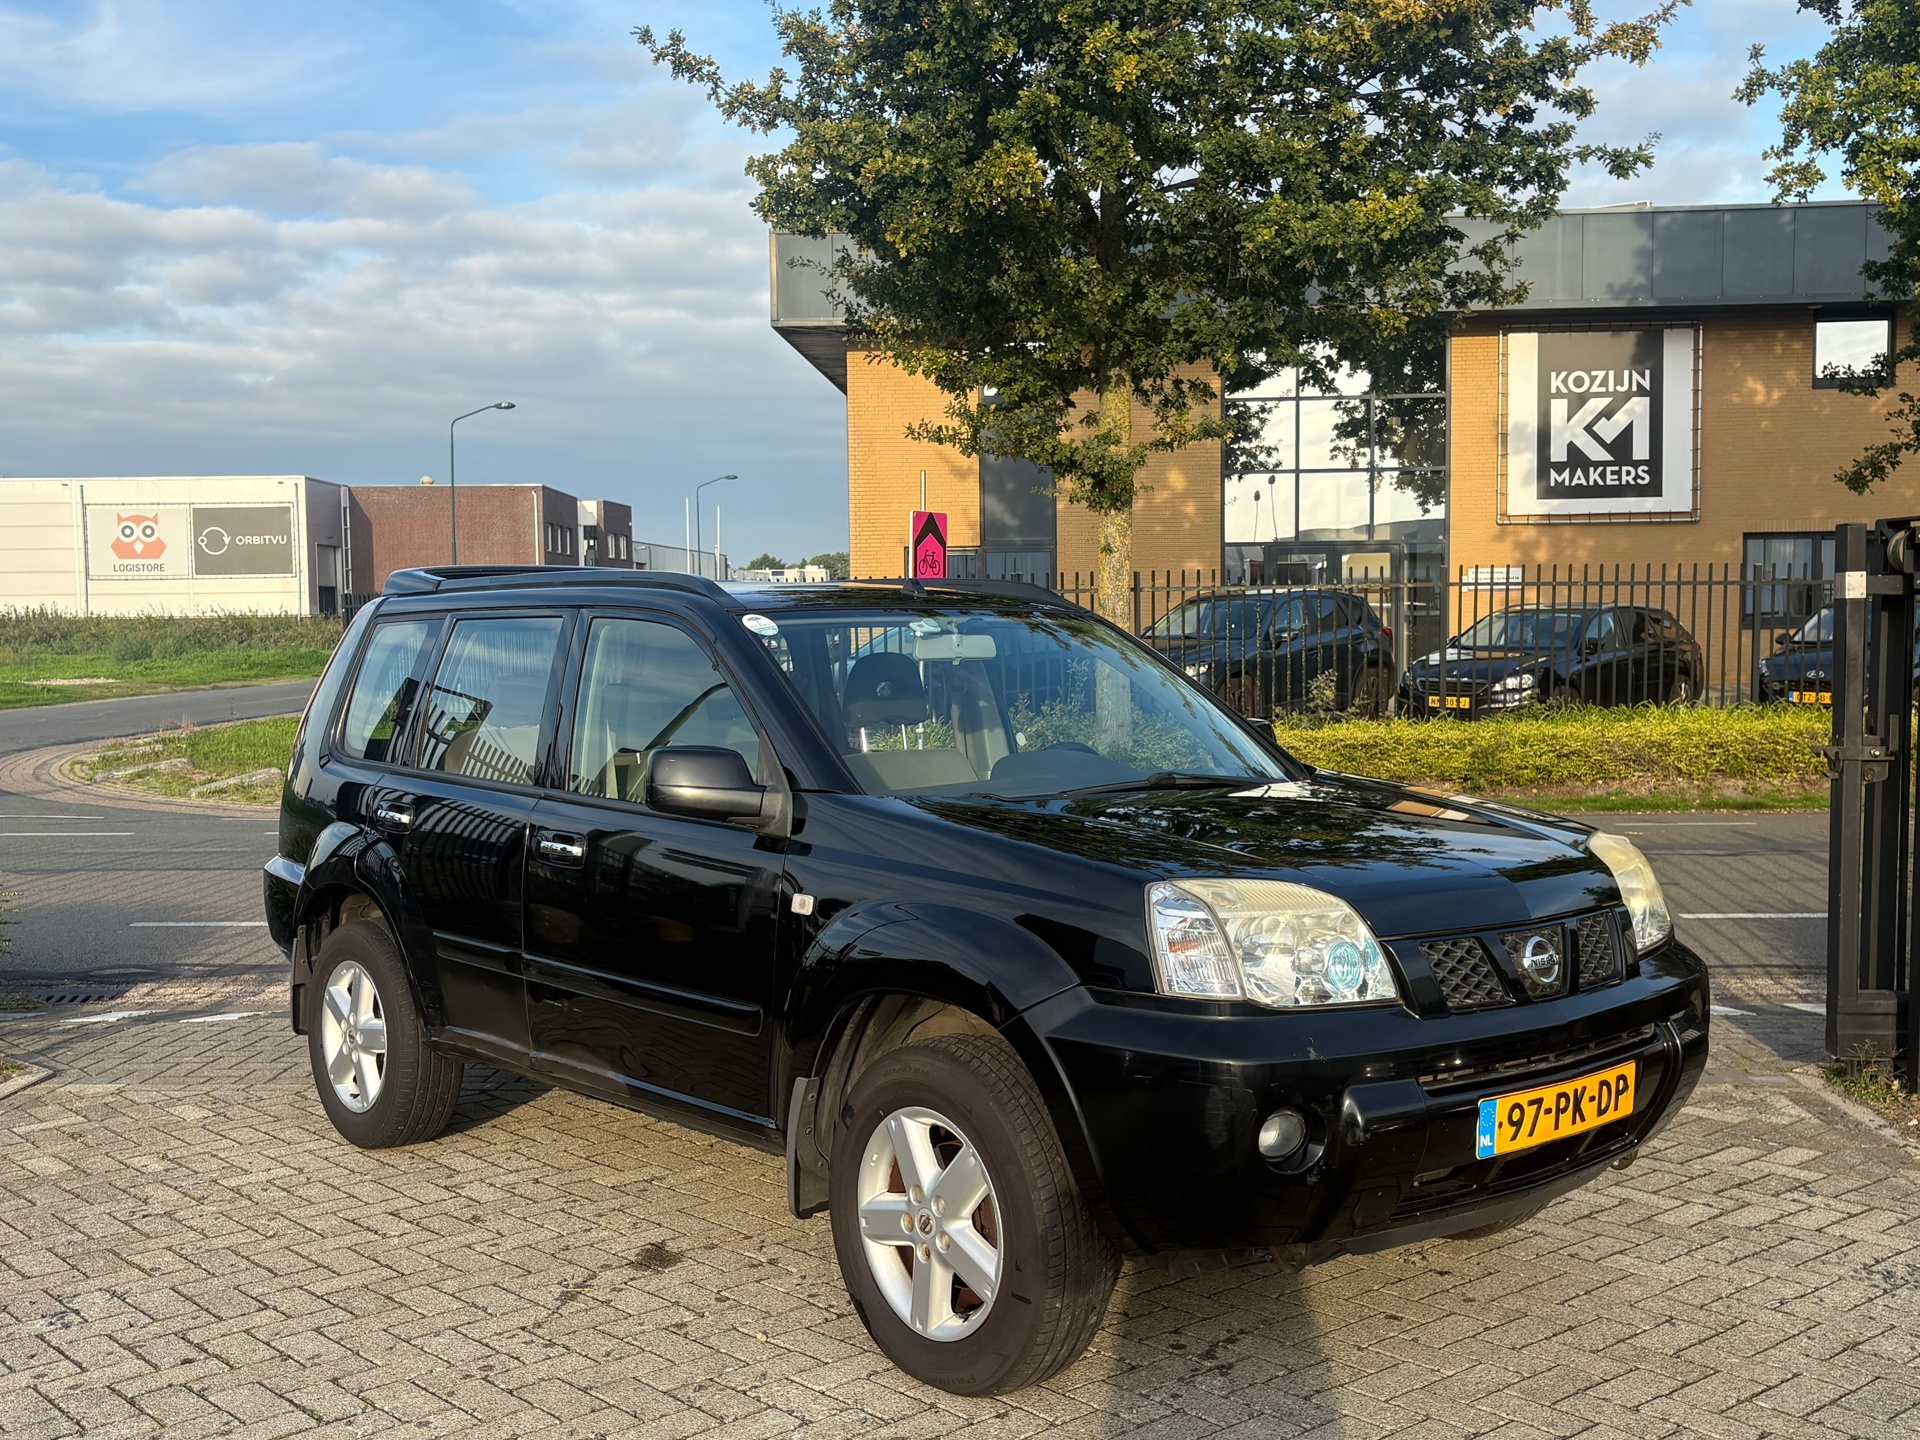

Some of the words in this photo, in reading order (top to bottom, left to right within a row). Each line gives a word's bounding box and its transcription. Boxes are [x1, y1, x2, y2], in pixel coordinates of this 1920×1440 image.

[1550, 369, 1650, 394] KOZIJN
[1550, 465, 1650, 487] MAKERS
[235, 535, 287, 546] ORBITVU
[113, 563, 165, 573] LOGISTORE
[1507, 1073, 1630, 1142] 97-PK-DP
[1480, 1134, 1494, 1148] NL
